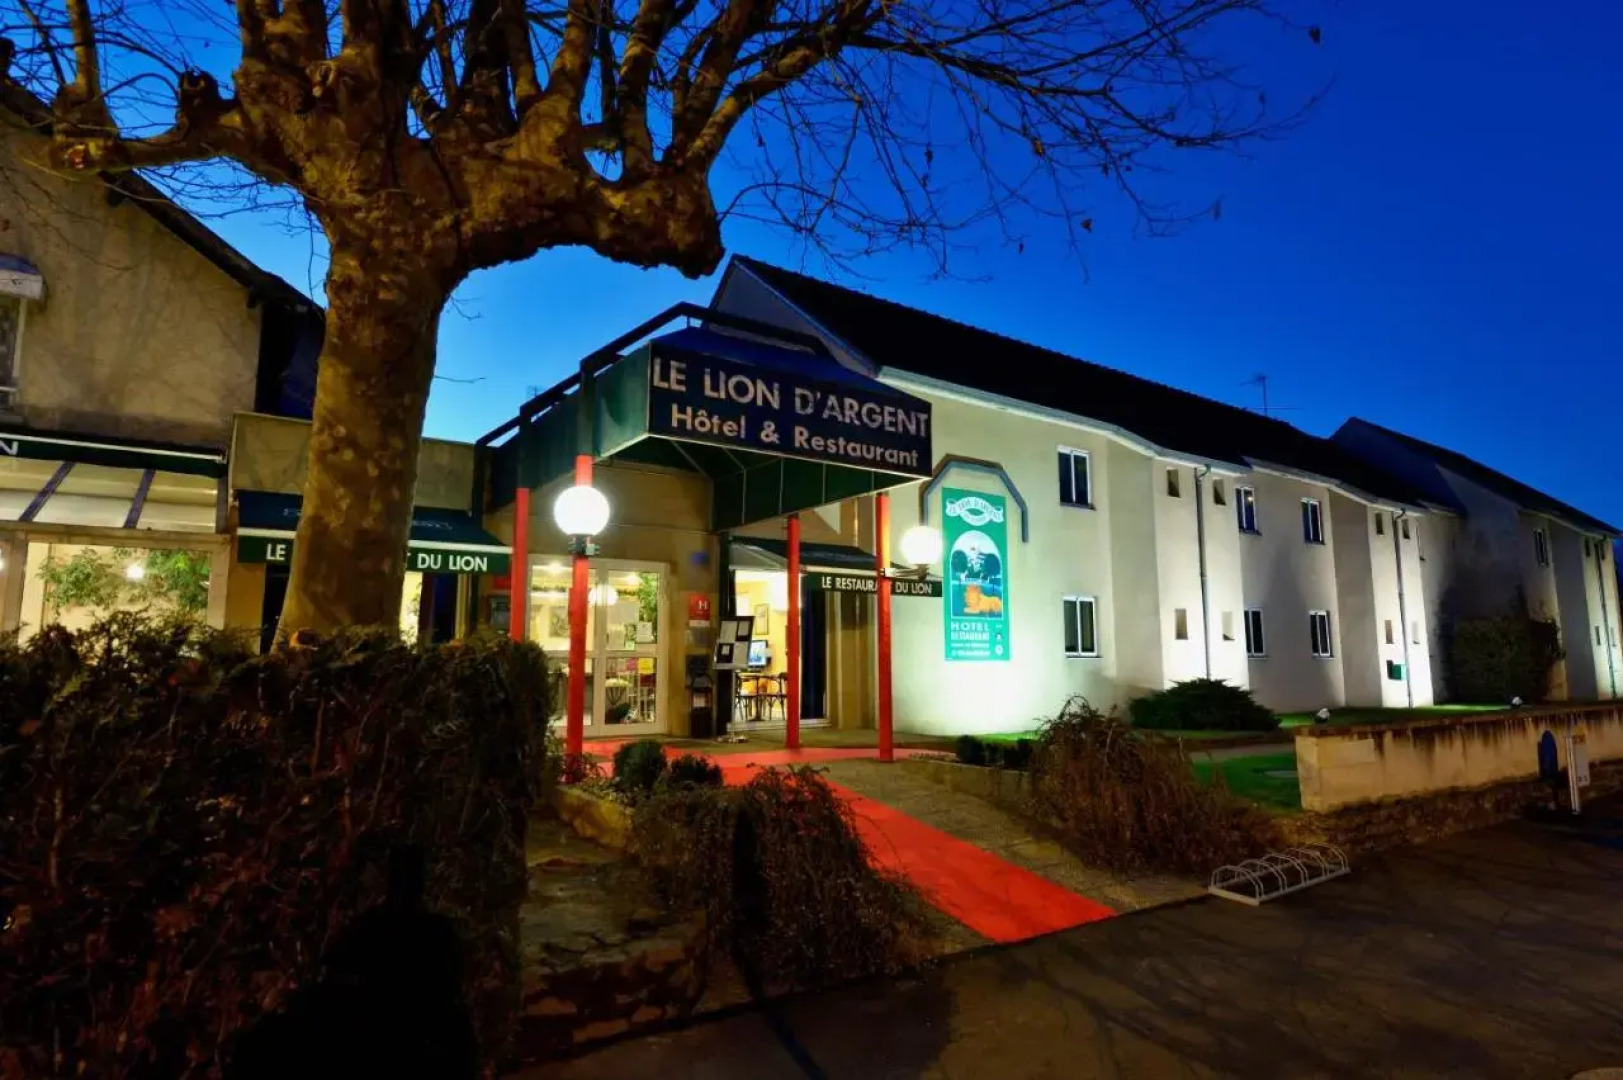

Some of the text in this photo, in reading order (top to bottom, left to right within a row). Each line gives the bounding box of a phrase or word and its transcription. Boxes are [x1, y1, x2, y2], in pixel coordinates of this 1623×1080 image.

[652, 356, 929, 438] LE LION D'ARGENT
[671, 403, 919, 467] Hôtel & Restaurant
[266, 543, 287, 561] LE
[417, 553, 442, 570] DU
[449, 555, 488, 572] LION
[821, 576, 933, 595] LE RESTAUR DU LION
